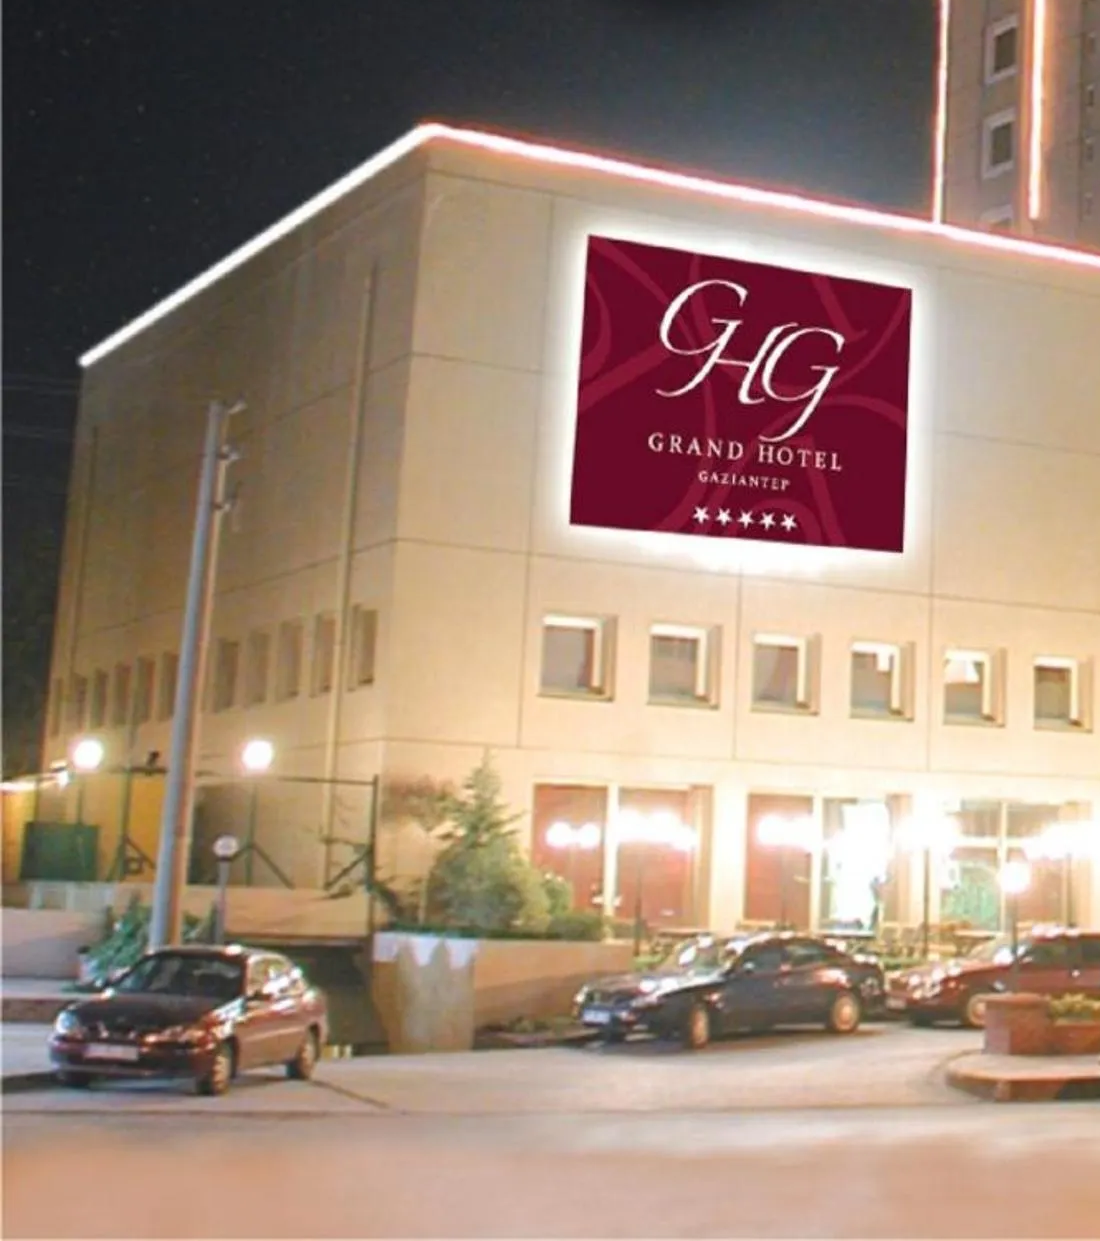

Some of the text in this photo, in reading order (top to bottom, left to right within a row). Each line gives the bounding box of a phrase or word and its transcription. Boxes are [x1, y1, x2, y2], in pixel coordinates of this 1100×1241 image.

[655, 279, 846, 443] GHG
[647, 432, 843, 472] GRAND HOTEL
[697, 470, 791, 492] GAZIANTEP
